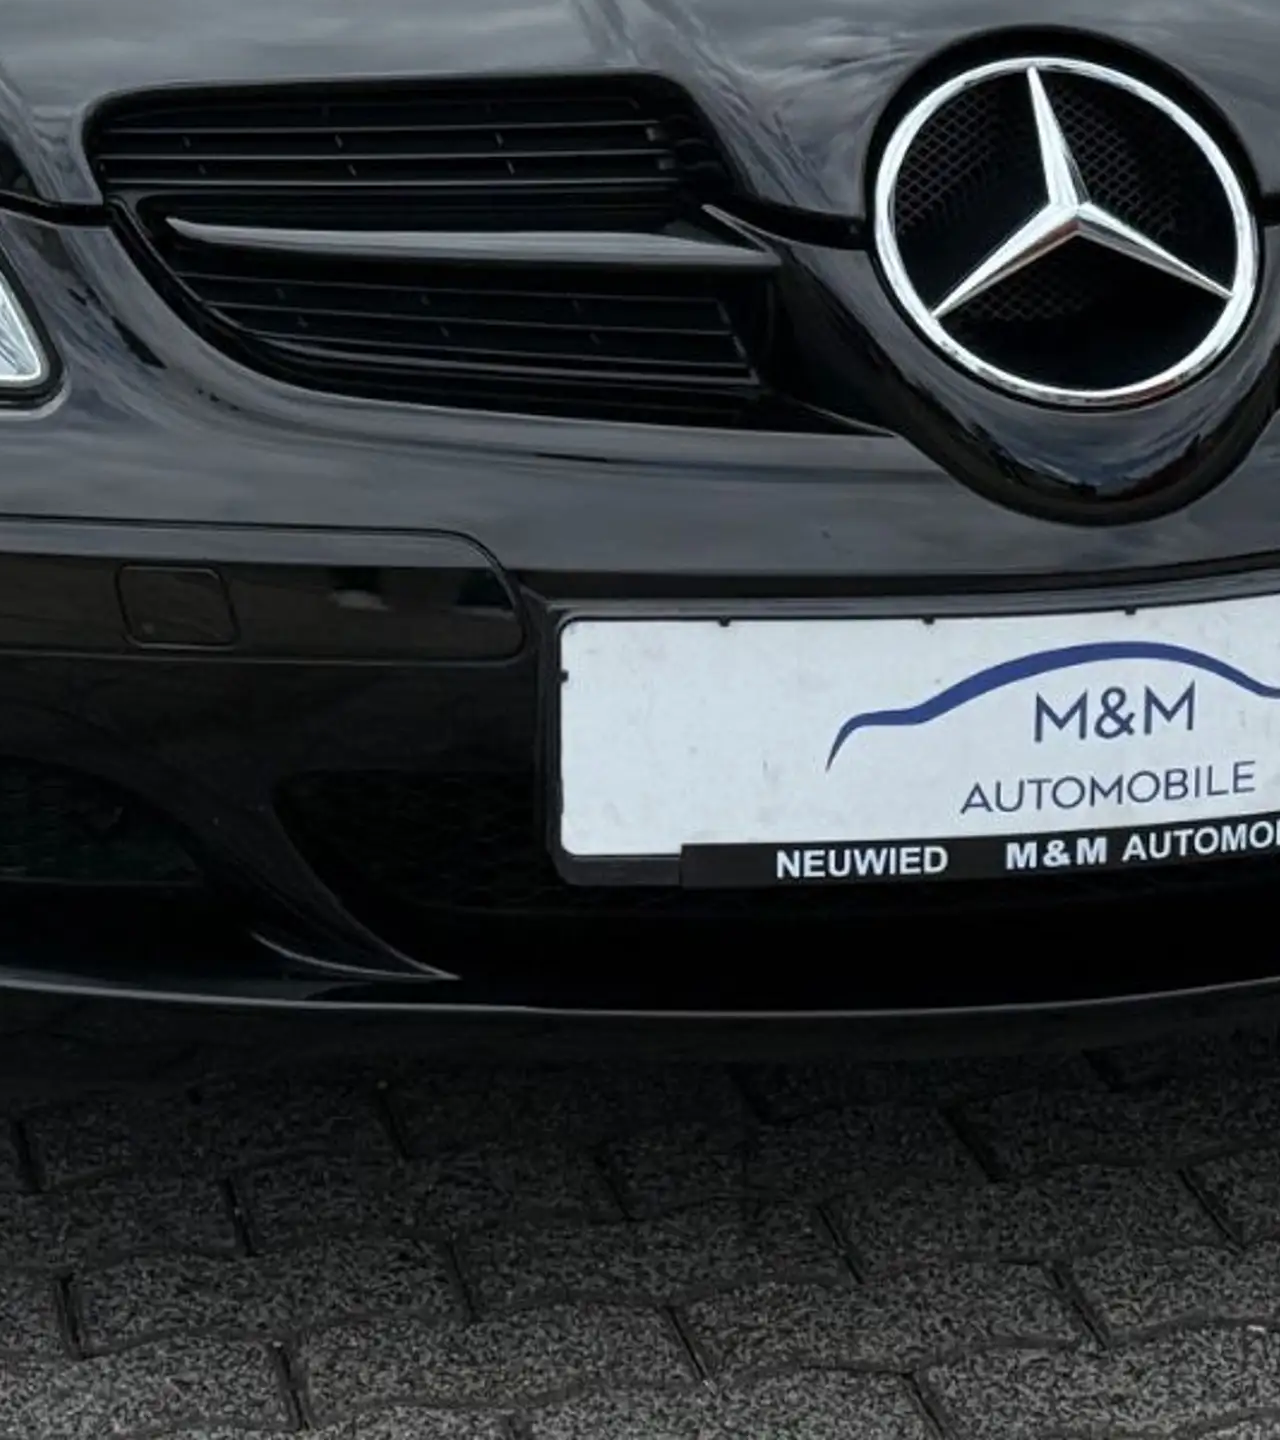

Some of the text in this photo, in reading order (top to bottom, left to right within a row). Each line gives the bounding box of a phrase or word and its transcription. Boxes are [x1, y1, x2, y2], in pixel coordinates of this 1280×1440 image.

[1034, 680, 1195, 743] M&M
[960, 760, 1256, 815] AUTOMOBILE
[775, 845, 949, 879] NEUWIED
[1005, 836, 1107, 871] M&M
